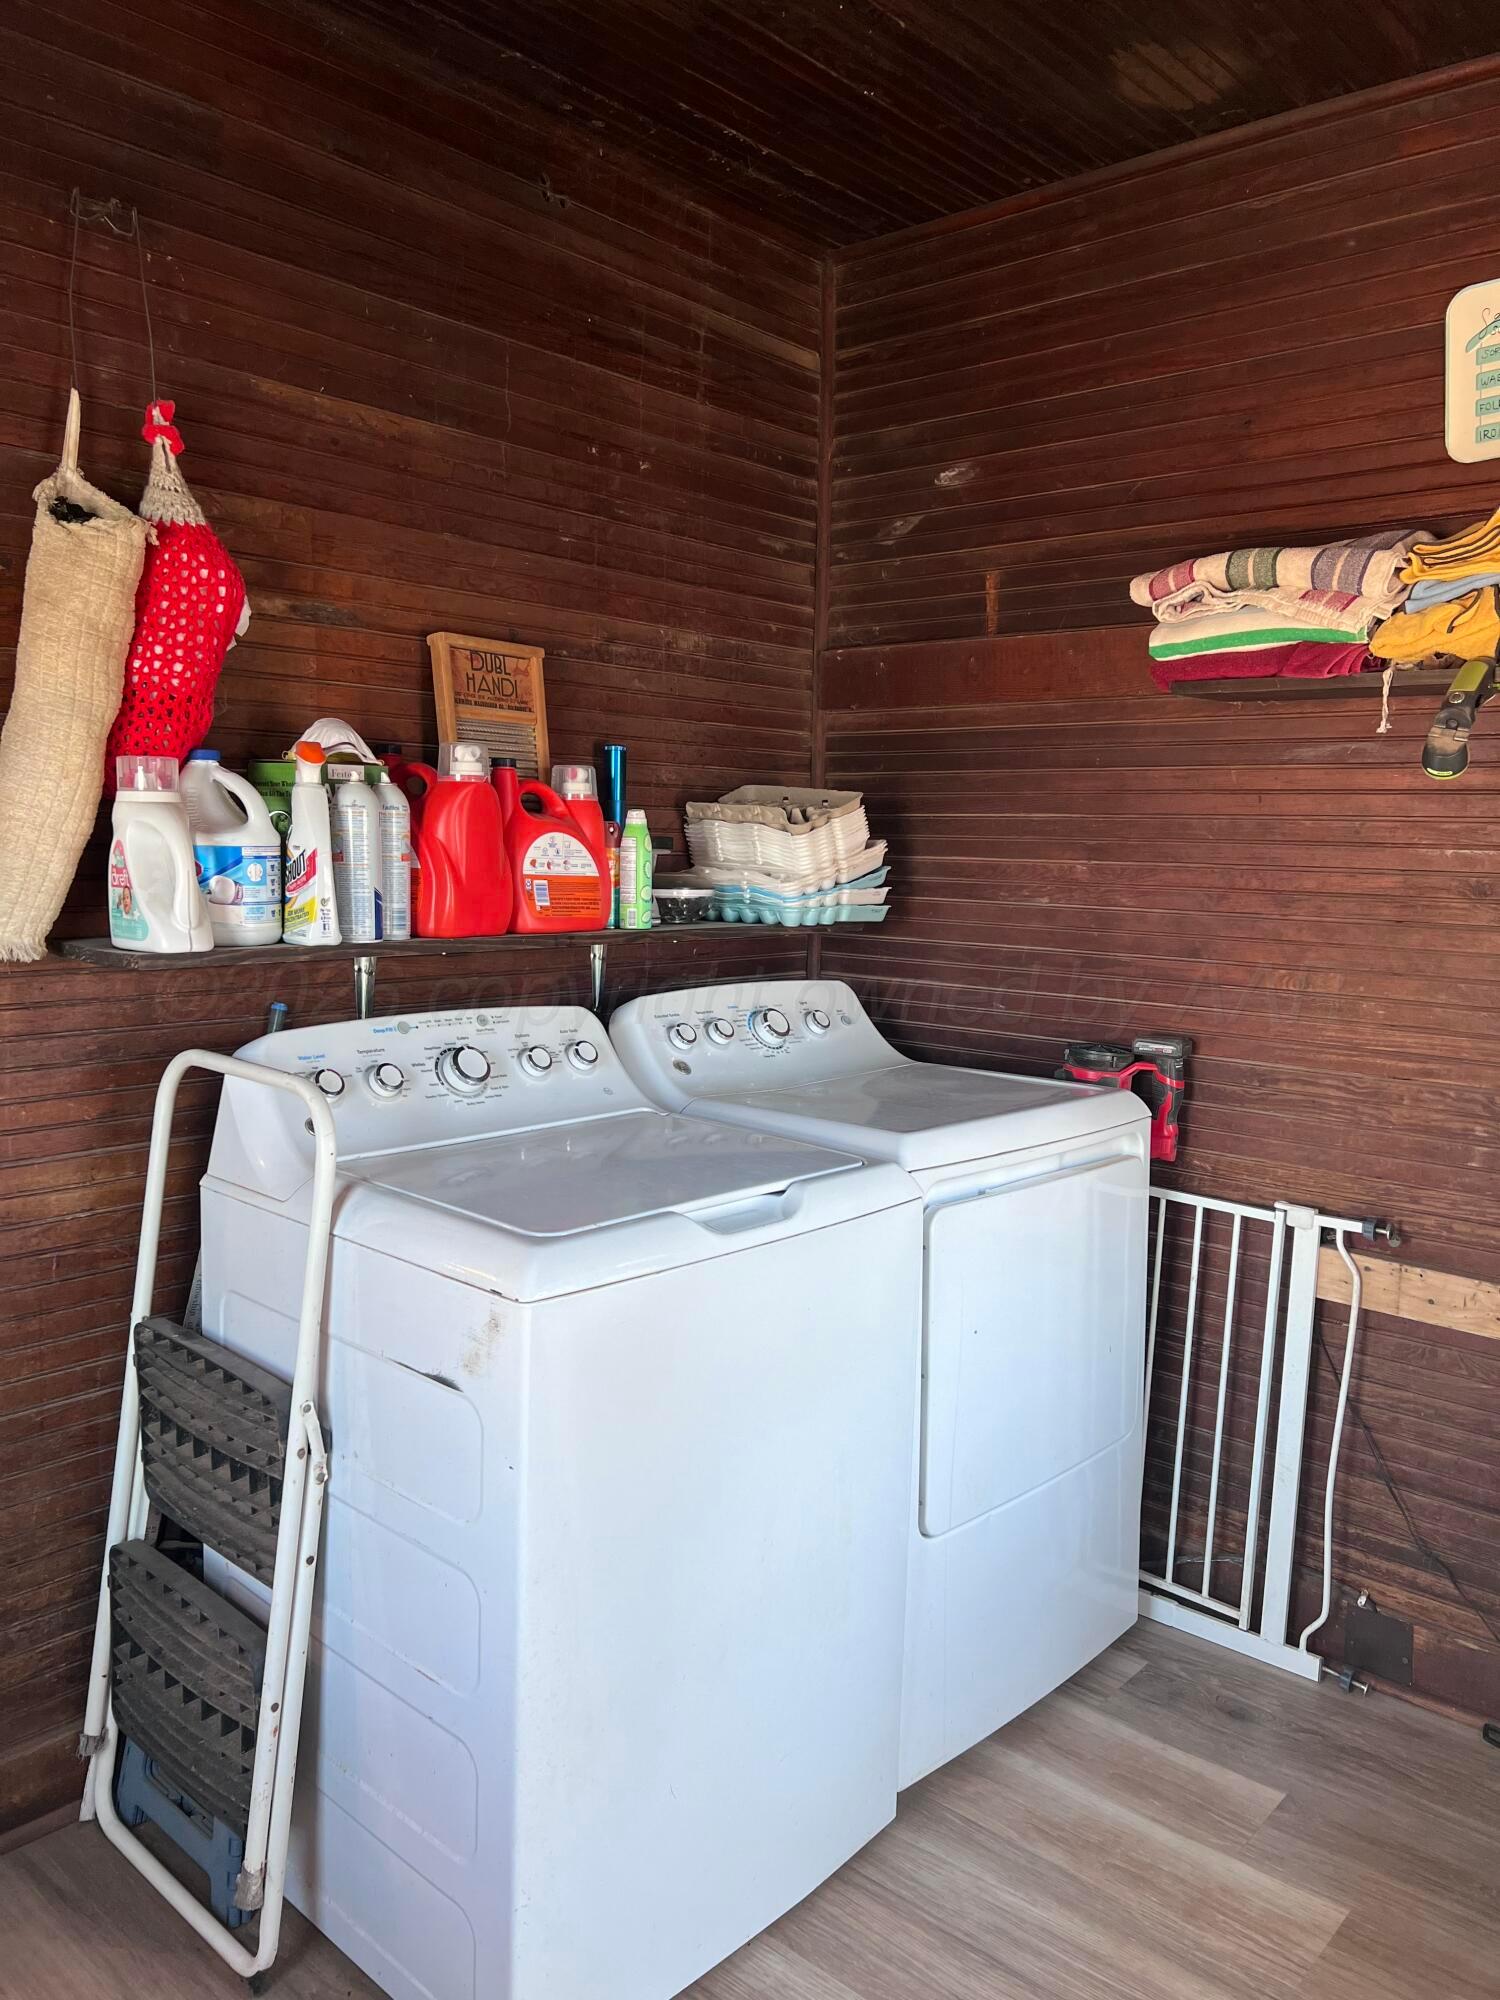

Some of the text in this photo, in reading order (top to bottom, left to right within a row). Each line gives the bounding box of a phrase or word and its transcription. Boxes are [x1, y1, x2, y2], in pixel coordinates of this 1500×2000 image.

[1480, 399, 1500, 412] FOL
[1480, 429, 1500, 442] IRO
[470, 650, 511, 676] DUBL
[466, 672, 518, 698] HANDI
[286, 848, 306, 882] HOUT
[357, 1047, 385, 1055] Temperature
